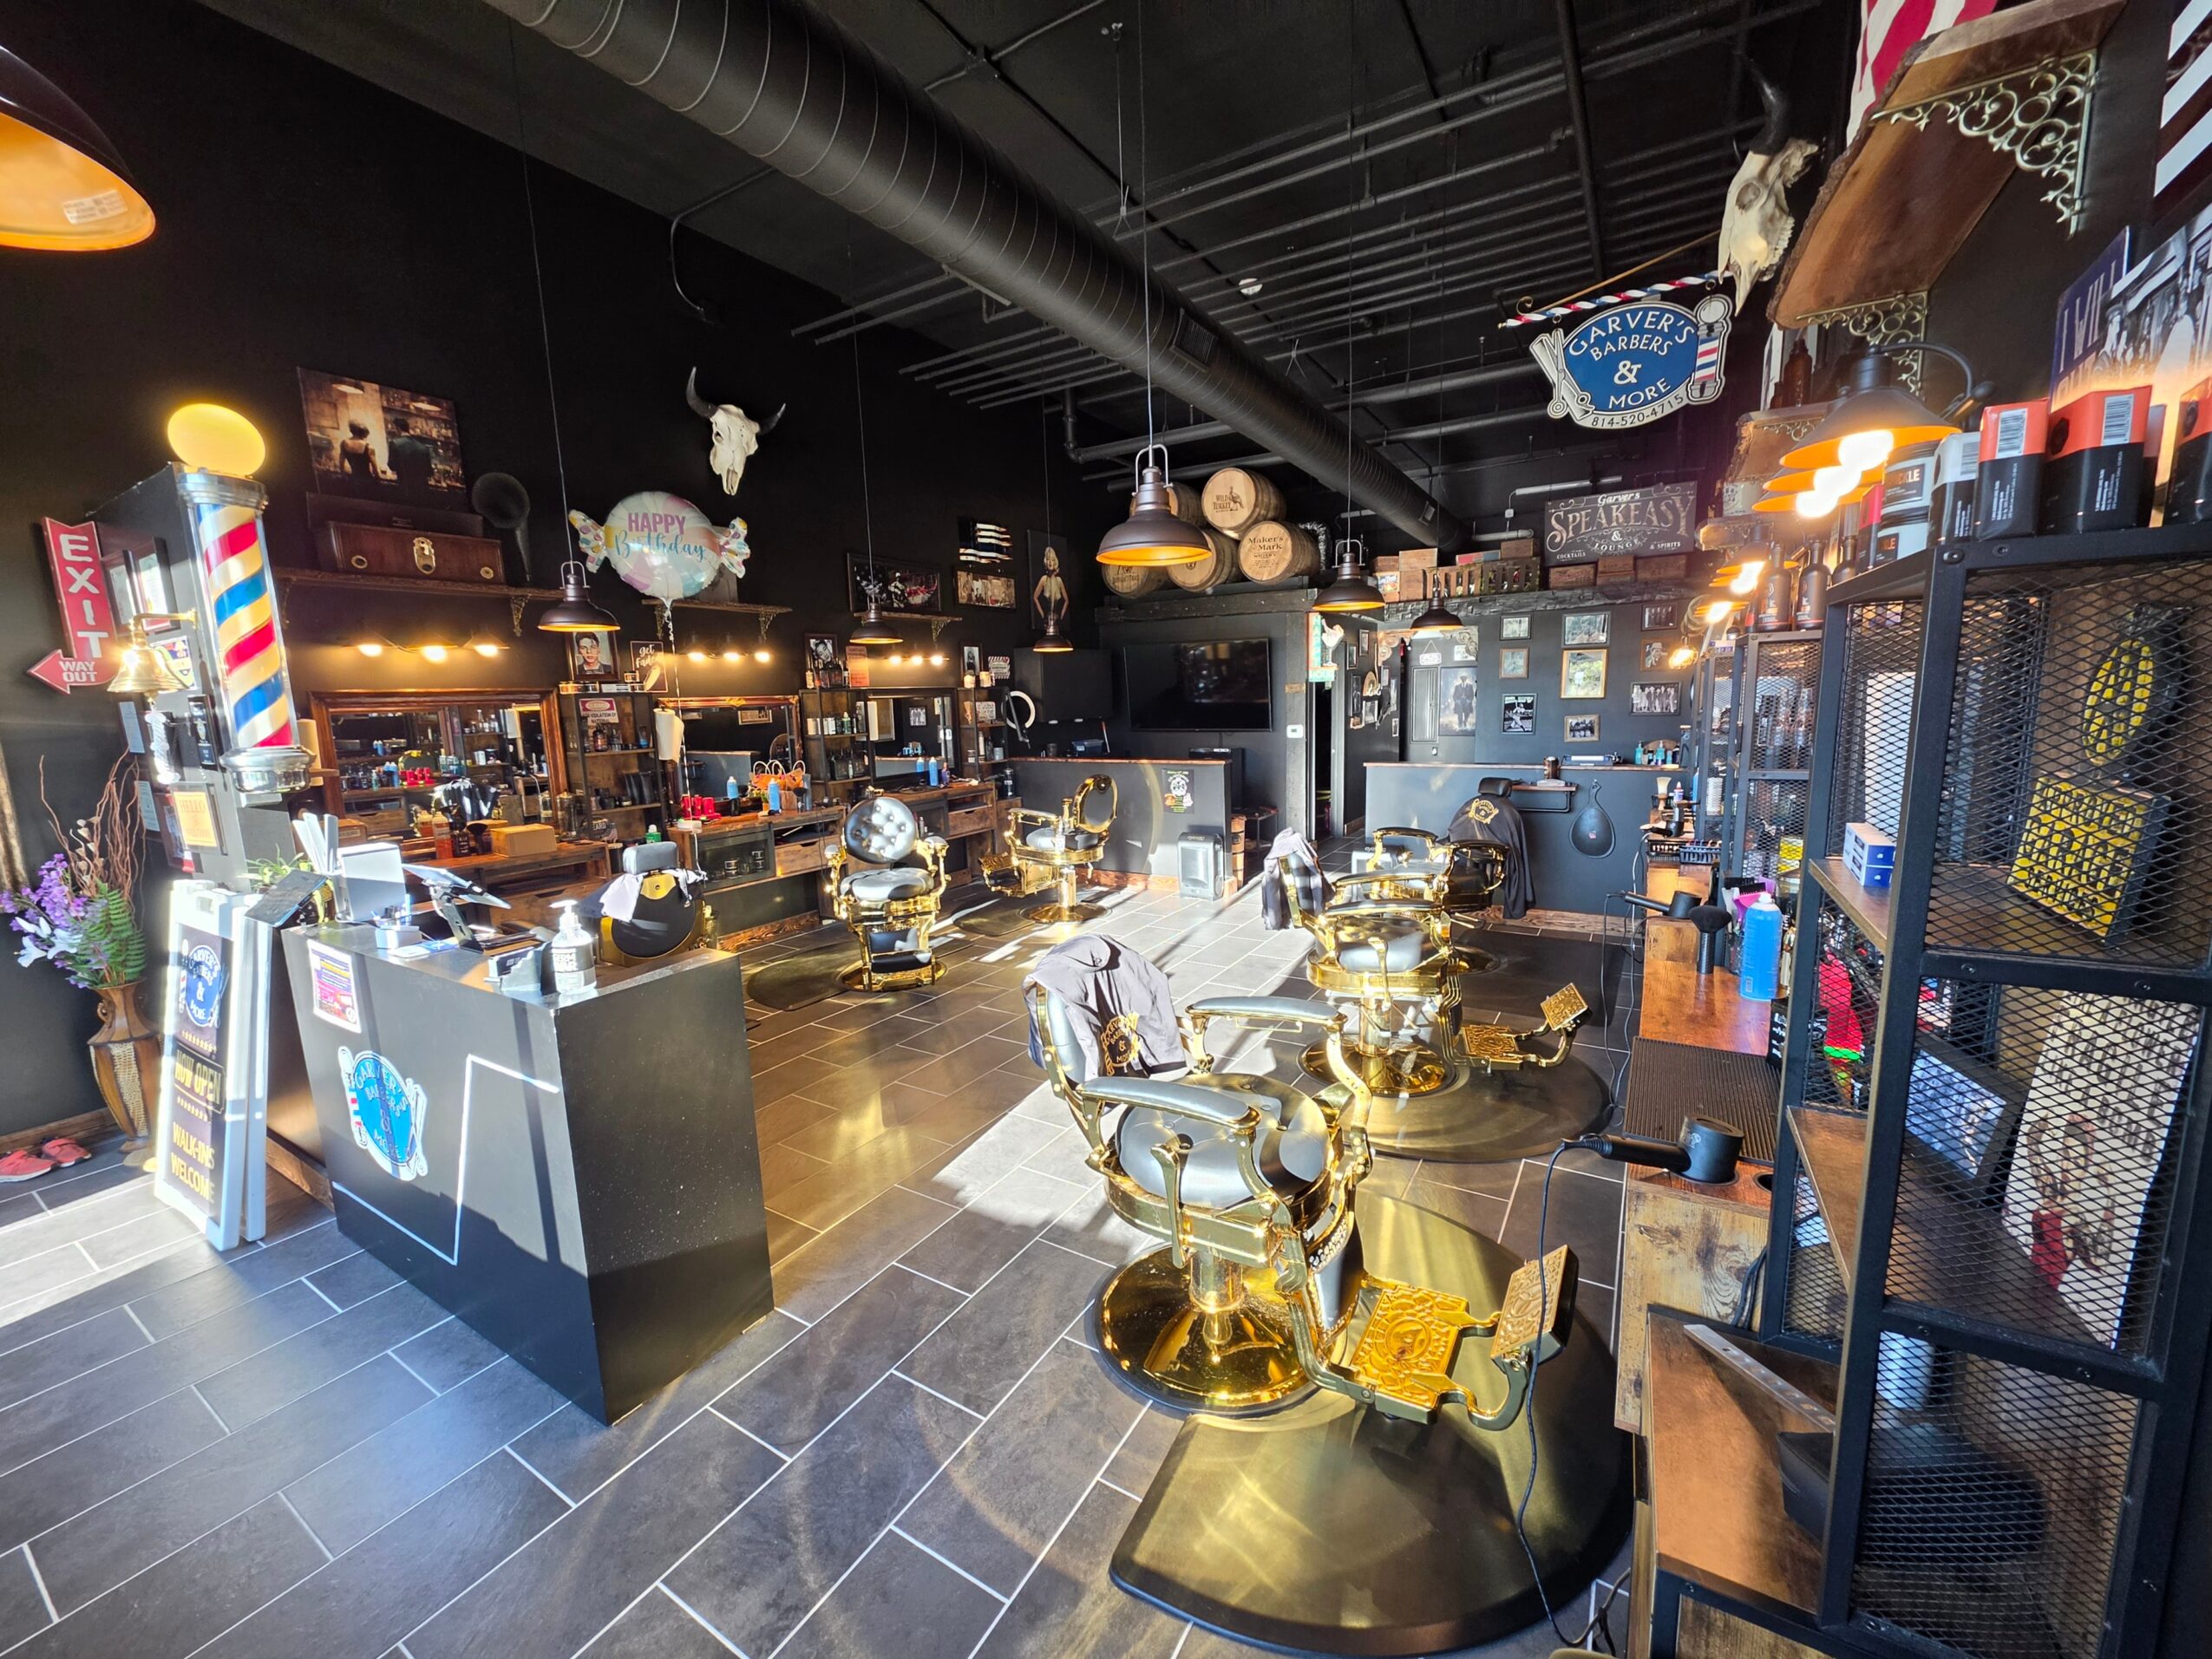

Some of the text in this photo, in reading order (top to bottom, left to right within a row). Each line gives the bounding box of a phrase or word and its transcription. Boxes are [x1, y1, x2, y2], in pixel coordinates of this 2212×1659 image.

[1568, 310, 1695, 356] GARVER'S
[1591, 334, 1673, 362] BARBERS
[1613, 360, 1641, 384] &
[1608, 377, 1672, 409] MORE
[1591, 394, 1685, 427] 814-520-4715
[627, 513, 686, 535] HAPPY
[1546, 495, 1696, 552] SPEAKEASY
[1594, 538, 1639, 552] LOUNGE
[1611, 530, 1623, 542] &
[1556, 551, 1587, 559] COCKTAILS
[59, 533, 109, 658] EXIT
[59, 661, 95, 673] WAY
[62, 672, 98, 683] OUT
[196, 981, 205, 1002] &
[190, 999, 206, 1020] MORE
[1119, 1040, 1126, 1051] &
[174, 1048, 223, 1105] NOW OPEN
[173, 1121, 215, 1171] WALK-INS
[171, 1152, 215, 1204] WELCOME
